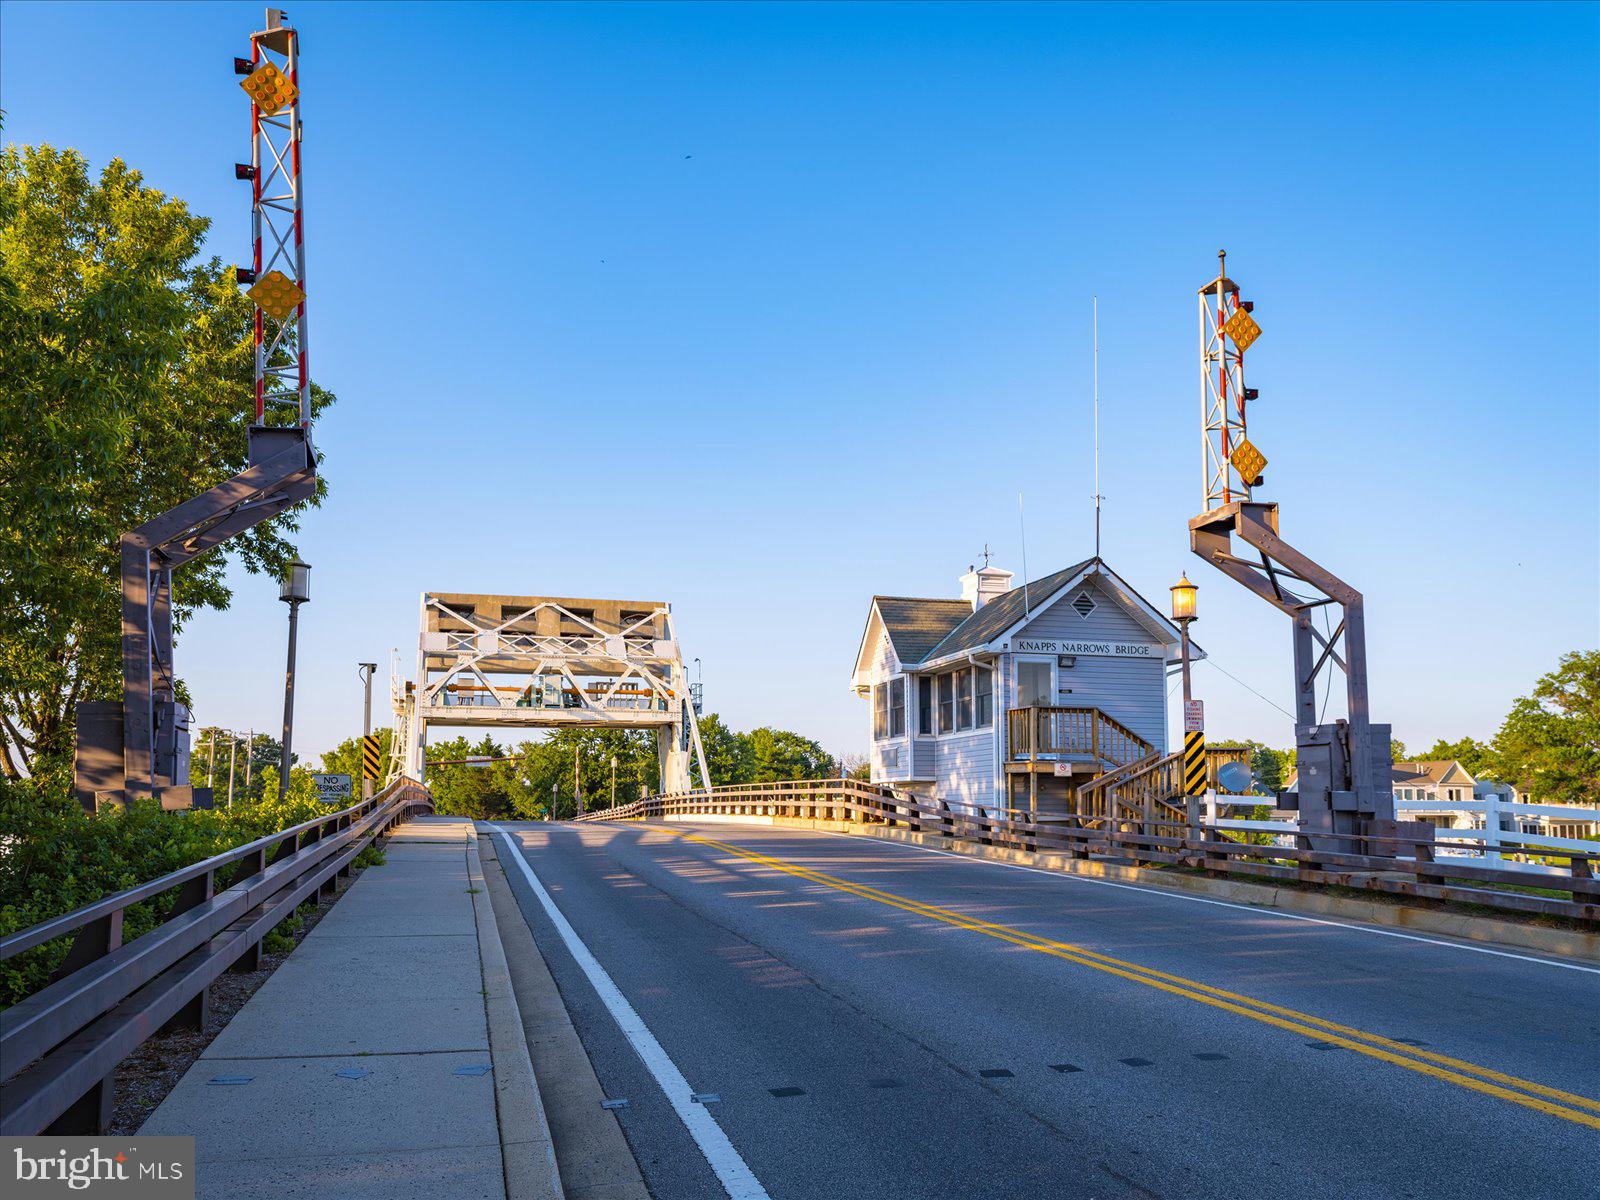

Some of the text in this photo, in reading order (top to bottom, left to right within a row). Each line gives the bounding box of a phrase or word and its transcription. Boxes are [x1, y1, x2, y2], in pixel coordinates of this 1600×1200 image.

[1018, 641, 1150, 655] KNAPPS NARROWS BRIDGE
[324, 776, 339, 784] NO
[316, 783, 349, 792] RESPASSING
